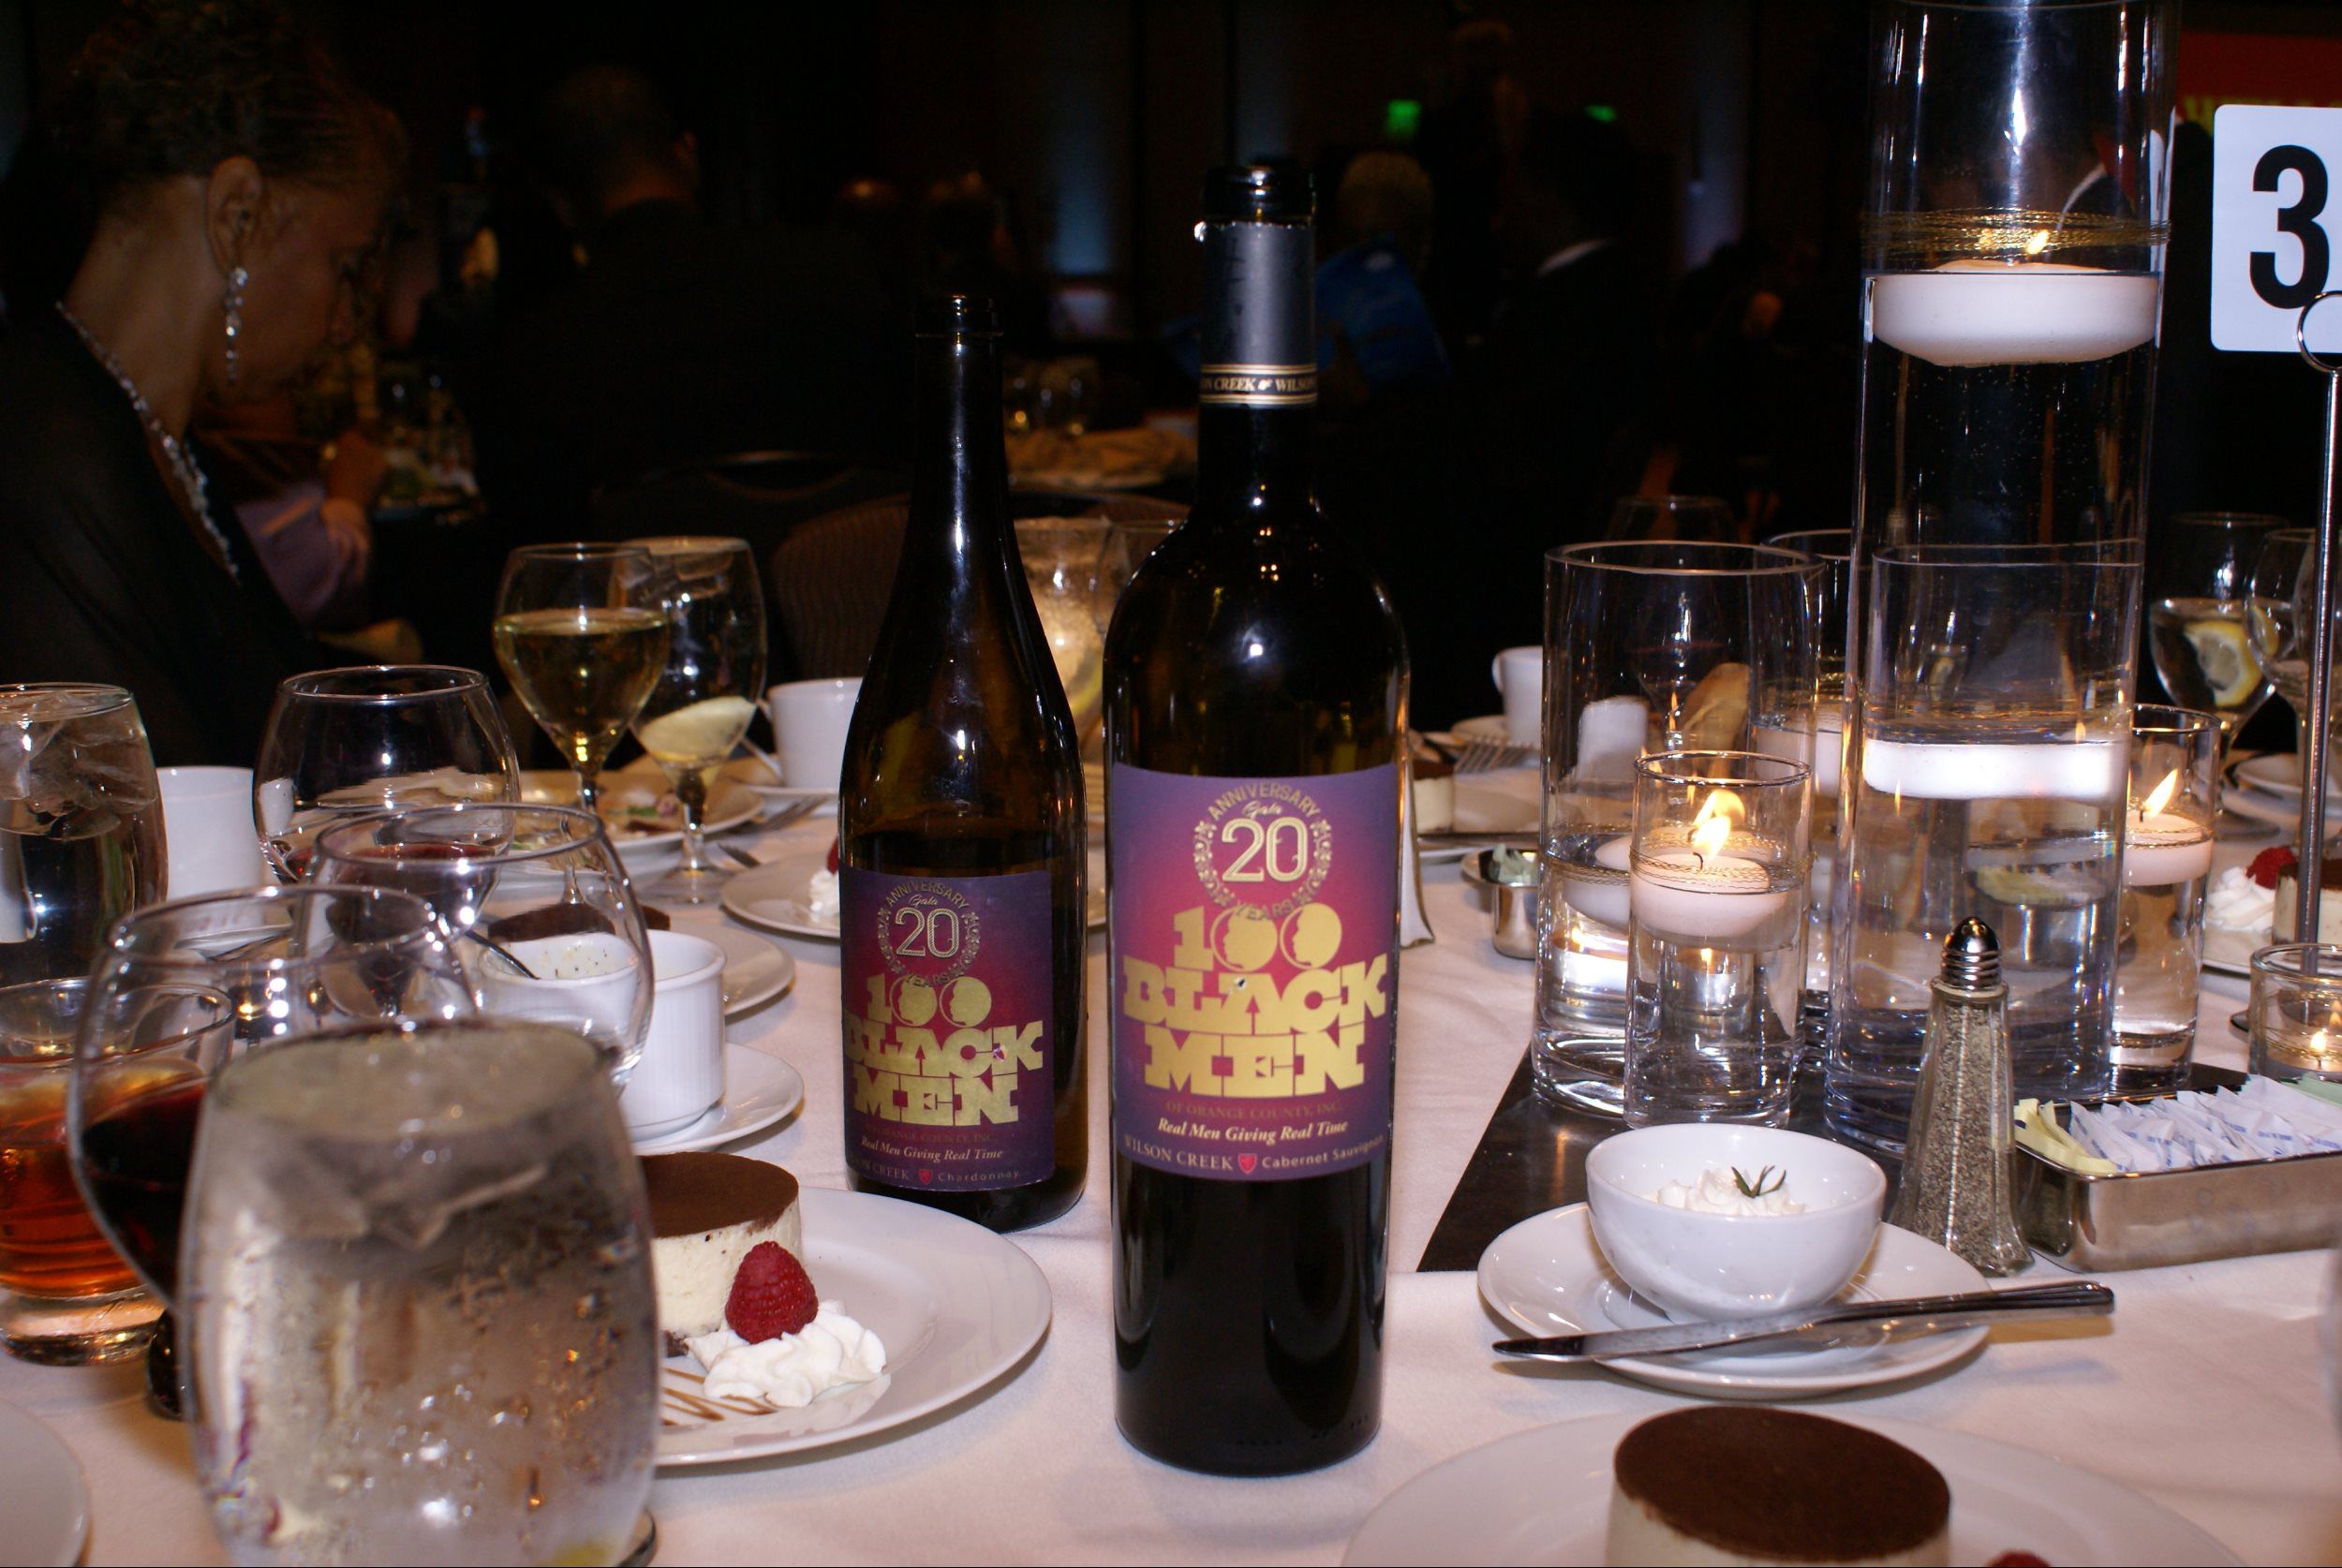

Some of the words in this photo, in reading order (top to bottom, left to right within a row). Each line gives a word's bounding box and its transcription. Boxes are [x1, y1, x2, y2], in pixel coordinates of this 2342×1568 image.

[2249, 144, 2330, 309] 3
[1213, 377, 1255, 392] CREEK
[1207, 781, 1322, 821] ANNIVERSARY
[1241, 800, 1282, 820] Gala
[1221, 817, 1309, 883] 20
[884, 880, 971, 910] ANNIVERSARY
[908, 894, 939, 908] Gala
[1235, 899, 1295, 922] YEARS
[895, 907, 959, 958] 20
[1173, 902, 1342, 972] 100
[905, 972, 950, 988] YEARS
[1123, 952, 1387, 1036] BLACK
[867, 973, 992, 1028] 100
[844, 1010, 1044, 1078] BLACK
[1144, 1021, 1365, 1098] MEN
[852, 1062, 1019, 1127] MEN
[1186, 1103, 1244, 1118] ORANGE
[1158, 1117, 1188, 1136] Real
[1189, 1123, 1221, 1141] Men
[1225, 1126, 1277, 1146] Giving
[1280, 1122, 1313, 1141] Real
[1316, 1120, 1349, 1137] Time
[862, 1135, 880, 1151] Real
[880, 1142, 901, 1156] Men
[903, 1146, 941, 1163] Giving
[943, 1148, 971, 1161] Real
[973, 1148, 1004, 1161] Time
[1176, 1150, 1234, 1171] CREEK
[1261, 1152, 1328, 1169] Cabernet
[872, 1161, 911, 1180] CREEK
[937, 1170, 1021, 1183] Chardonnay
